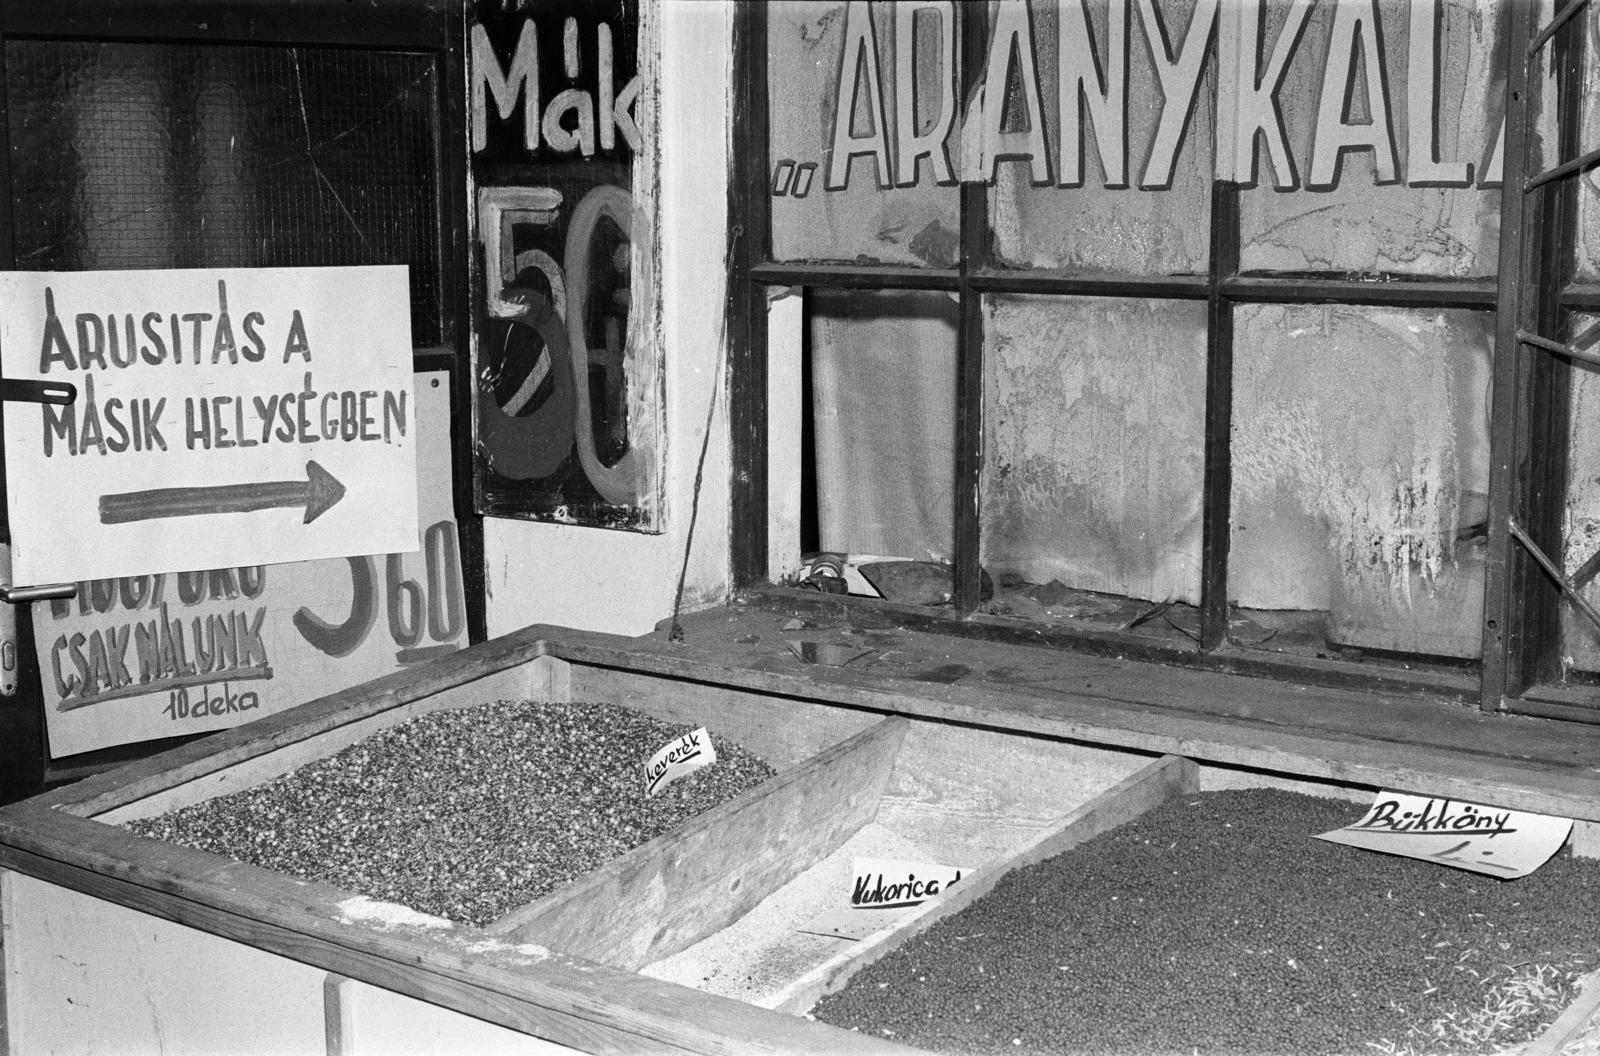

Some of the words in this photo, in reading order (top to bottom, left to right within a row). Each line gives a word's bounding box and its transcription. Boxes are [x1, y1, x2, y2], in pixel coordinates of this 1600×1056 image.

[471, 16, 644, 157] Mák
[39, 279, 266, 374] ÁRUSITÁS
[282, 309, 312, 364] A
[42, 373, 168, 457] MÁSIK
[184, 371, 406, 453] HELYSÉGBEN
[52, 623, 133, 699] CSAK
[134, 601, 269, 686] NÁLUNK
[162, 688, 190, 721] 10
[190, 682, 260, 719] deka
[1361, 799, 1511, 839] Bükköny
